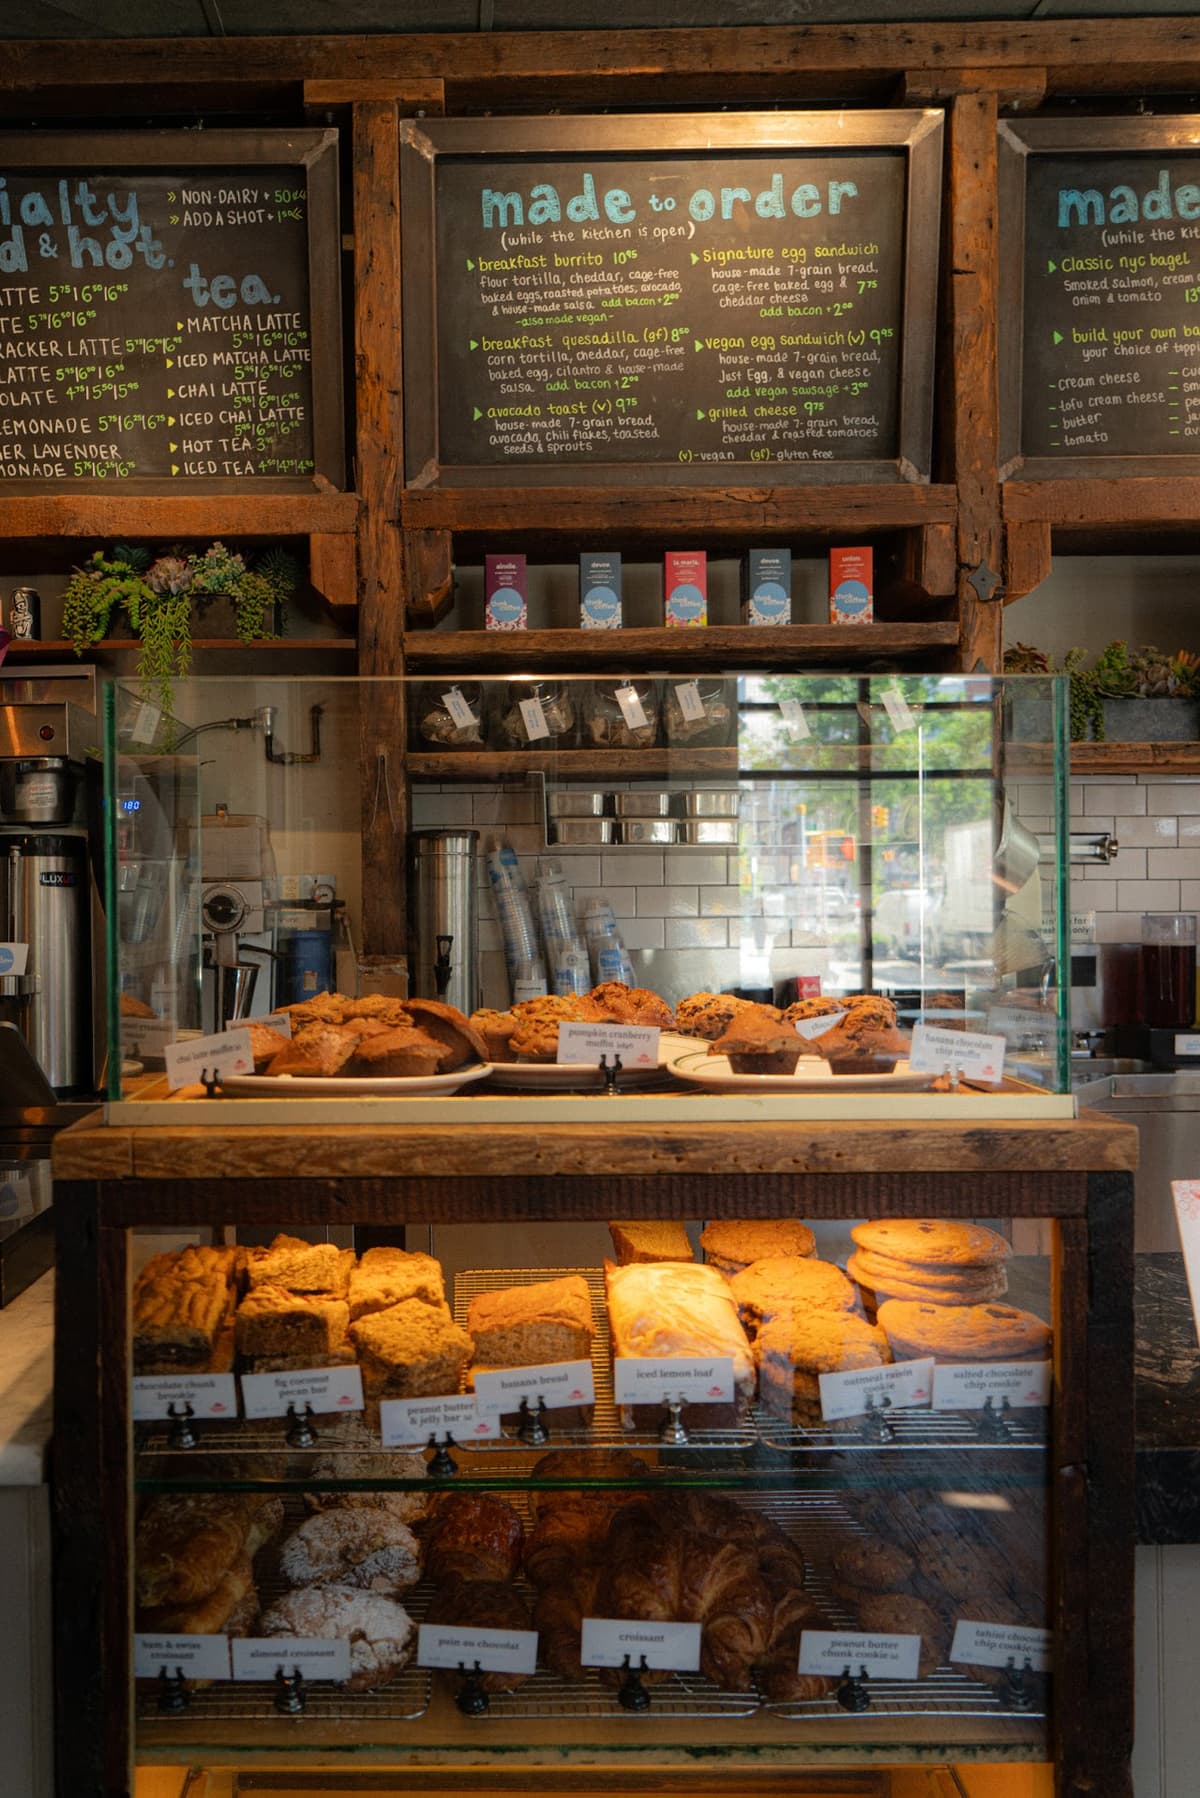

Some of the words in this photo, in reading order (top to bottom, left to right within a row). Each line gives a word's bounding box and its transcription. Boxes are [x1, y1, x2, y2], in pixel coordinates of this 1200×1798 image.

[182, 188, 258, 205] NON-DAIRY
[482, 173, 637, 228] made
[649, 194, 676, 212] to
[689, 173, 858, 221] order
[1058, 170, 1200, 228] made
[183, 210, 212, 226] ADD
[216, 211, 224, 226] A
[227, 209, 265, 224] SHOT
[501, 231, 544, 251] (while
[550, 230, 575, 242] the
[582, 226, 631, 240] kitchen
[638, 224, 648, 236] is
[653, 221, 696, 242] open)
[1102, 230, 1145, 247] (while
[1150, 228, 1176, 240] the
[39, 233, 58, 259] &
[782, 250, 807, 263] egg
[815, 243, 879, 258] sandwich
[479, 256, 548, 271] breakfast
[554, 253, 603, 267] burrito
[1120, 256, 1146, 273] nyc
[1150, 252, 1190, 271] bagel
[480, 275, 508, 288] flour
[512, 272, 565, 286] tortilla,
[570, 271, 623, 284] cheddar,
[629, 269, 679, 281] cage-free
[712, 268, 781, 279] house-made
[788, 264, 832, 279] 7-grain
[1162, 274, 1194, 284] cream
[183, 263, 280, 309] tea.
[481, 292, 514, 303] baked
[587, 285, 638, 298] potatoes,
[712, 281, 770, 294] cage-free
[774, 281, 810, 292] baked
[815, 280, 833, 292] egg
[501, 302, 560, 315] house-made
[564, 301, 594, 310] salsa
[602, 298, 622, 308] add
[625, 297, 655, 306] bacon
[720, 295, 764, 307] cheddar
[770, 293, 809, 304] cheese
[1107, 294, 1114, 303] &
[1118, 291, 1162, 302] tomato
[760, 307, 783, 317] add
[788, 304, 822, 316] bacon
[187, 315, 252, 334] MATCHA
[257, 313, 300, 331] LATTE
[483, 335, 553, 350] breakfast
[563, 331, 639, 349] quesadilla
[644, 328, 668, 343] (gf)
[705, 336, 745, 351] vegan
[751, 335, 776, 350] egg
[780, 330, 844, 346] sandwich
[848, 330, 865, 346] (v)
[1072, 328, 1108, 343] build
[1113, 329, 1144, 346] your
[1150, 327, 1176, 340] own
[68, 338, 123, 357] LATTE
[487, 355, 515, 365] corn
[519, 351, 573, 364] tortilla,
[576, 348, 629, 361] cheddar,
[633, 346, 685, 359] cage-free
[1082, 348, 1108, 362] your
[1114, 345, 1151, 356] choice
[1156, 343, 1169, 353] of
[178, 354, 207, 368] ICED
[213, 351, 269, 366] MATCHA
[274, 349, 311, 362] LATTE
[719, 353, 788, 364] house-made
[793, 352, 837, 365] 7-grain
[842, 350, 880, 363] bread,
[489, 369, 524, 380] baked
[557, 366, 600, 376] cilantro
[618, 362, 684, 374] house-made
[719, 371, 742, 383] Just
[747, 370, 772, 383] Egg,
[789, 368, 824, 382] vegan
[830, 367, 871, 378] cheese
[178, 383, 215, 398] CHAI
[222, 380, 268, 396] LATTE
[500, 382, 534, 394] salsa
[546, 381, 569, 391] add
[575, 379, 610, 389] bacon
[1058, 376, 1095, 391] cream
[1100, 372, 1141, 386] cheese
[0, 389, 58, 406] OLATE
[726, 386, 750, 397] add
[755, 385, 788, 400] vegan
[792, 384, 839, 397] sausage
[488, 405, 540, 418] avocado
[547, 402, 588, 415] toast
[592, 399, 612, 414] (v)
[1059, 398, 1083, 412] tofu
[1088, 395, 1122, 406] cream
[1127, 392, 1166, 403] cheese
[180, 412, 213, 426] ICED
[219, 410, 252, 424] CHAI
[259, 407, 305, 422] LATTE
[709, 406, 747, 422] grilled
[754, 404, 797, 417] cheese
[1063, 412, 1102, 429] butter
[0, 417, 91, 436] EMONADE
[495, 419, 561, 431] house-made
[569, 417, 613, 430] 7-grain
[613, 427, 660, 439] toasted
[722, 419, 789, 432] house-made
[722, 432, 766, 444] cheddar
[783, 429, 824, 441] roasted
[826, 427, 879, 438] tomatoes
[1064, 432, 1108, 446] tomato
[33, 444, 122, 460] LAVENDER
[183, 440, 213, 453] HOT
[219, 437, 252, 452] TEA
[504, 444, 534, 454] seeds
[547, 441, 593, 454] sprouts
[184, 461, 217, 475] ICED
[223, 460, 255, 475] TEA
[123, 800, 141, 811] 180
[636, 1368, 658, 1379] iced
[660, 1368, 692, 1379] lemon
[618, 1631, 666, 1643] croissant
